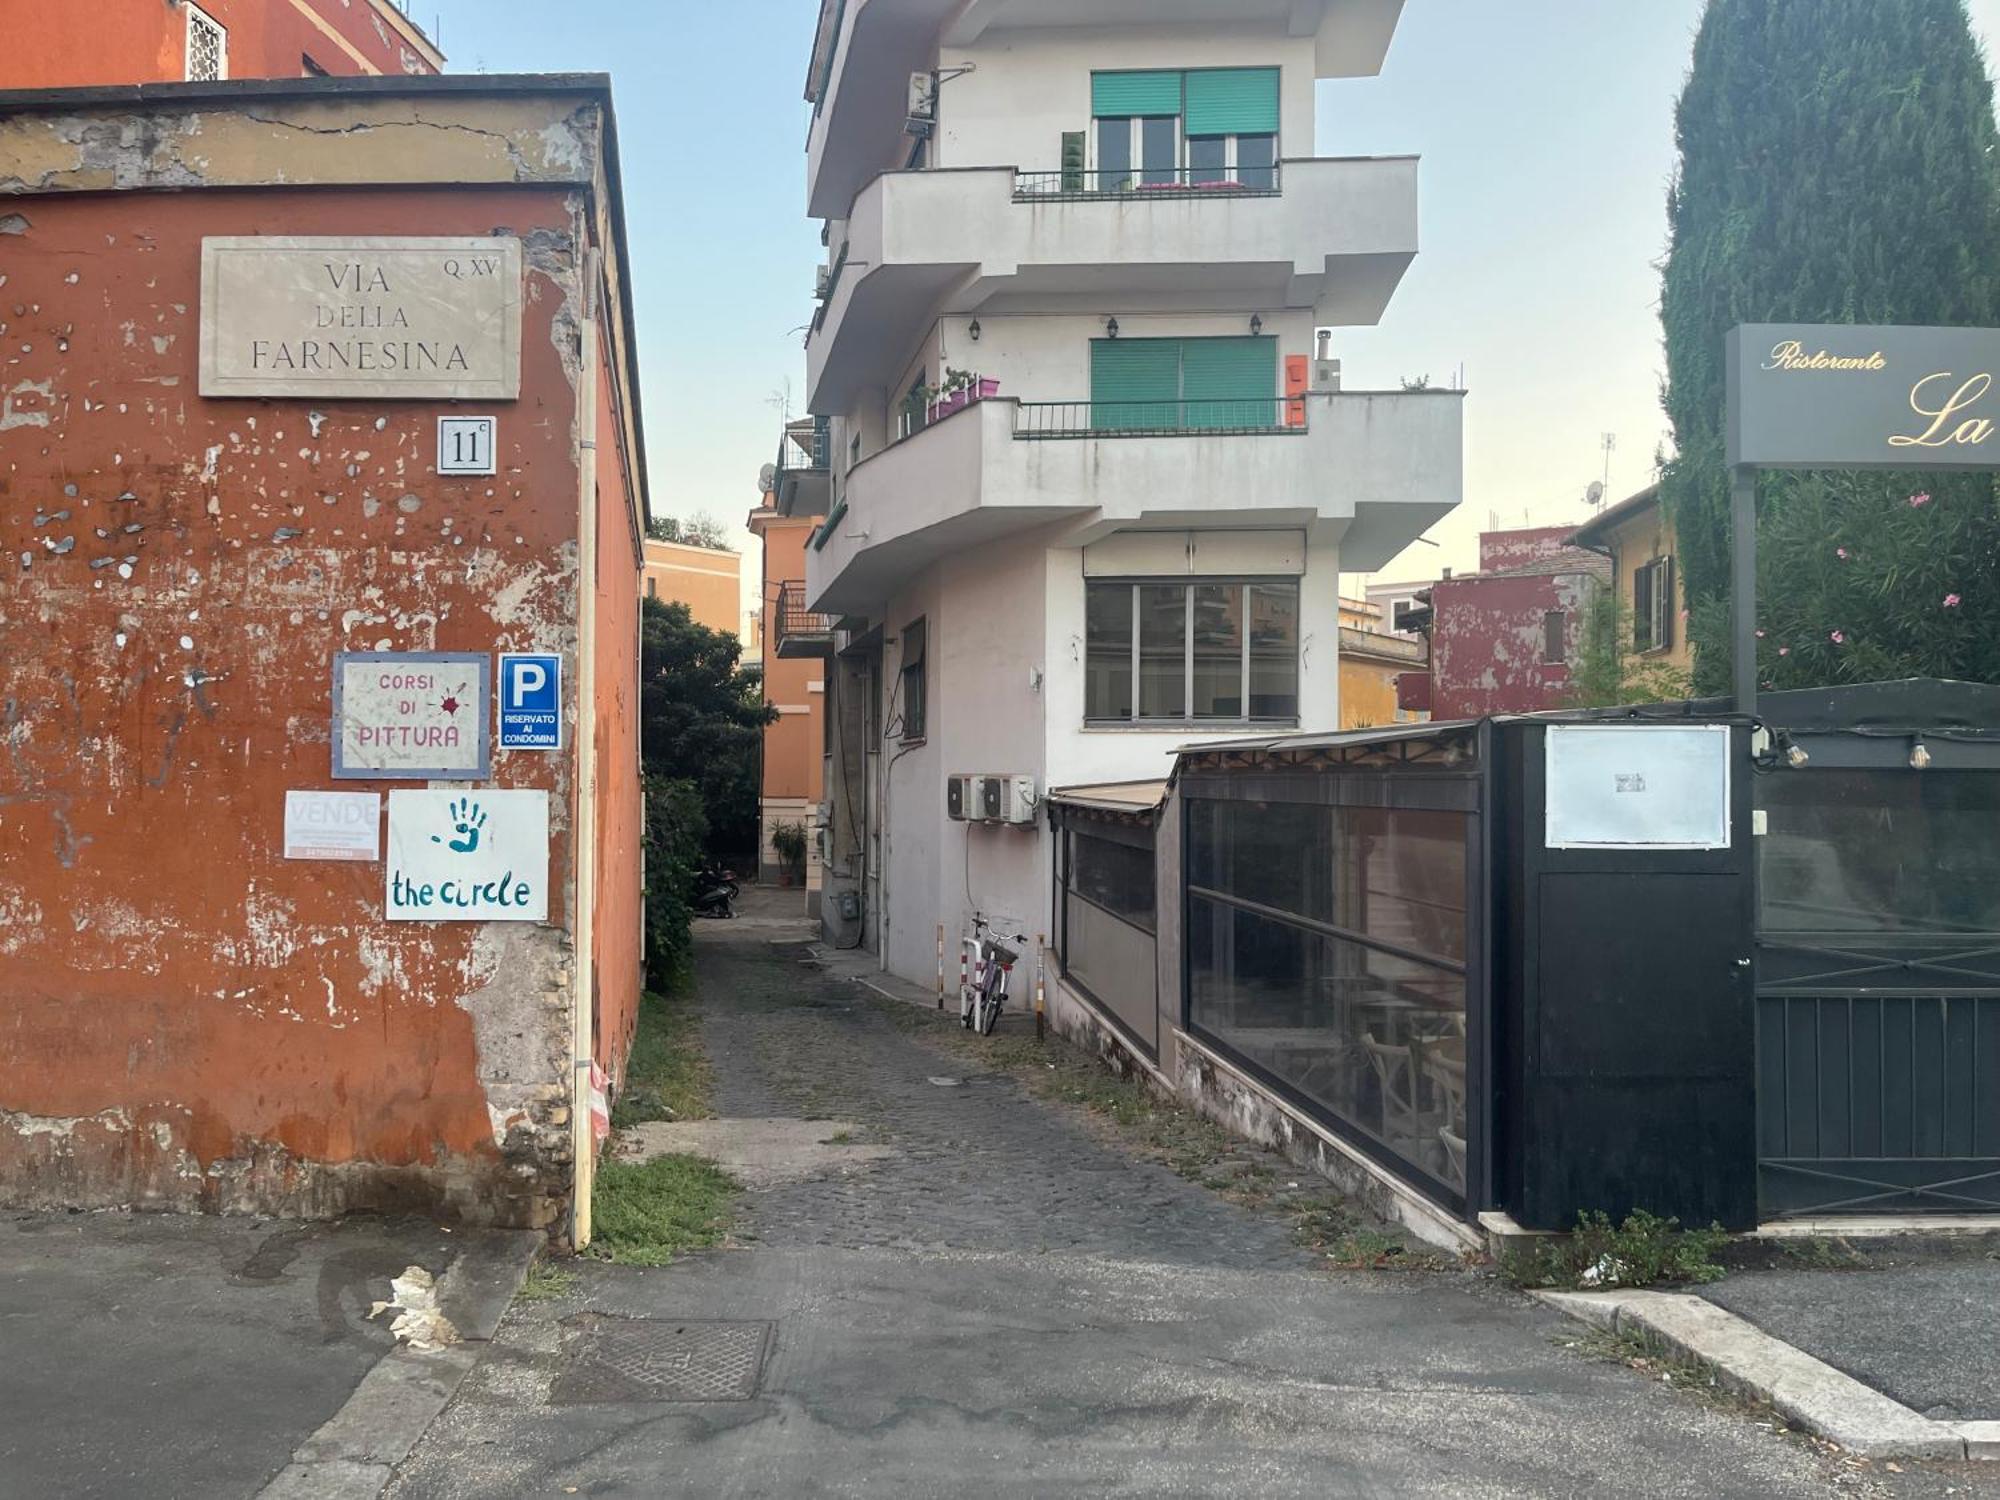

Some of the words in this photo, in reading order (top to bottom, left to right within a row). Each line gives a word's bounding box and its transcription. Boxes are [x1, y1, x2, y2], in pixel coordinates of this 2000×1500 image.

[471, 259, 498, 275] XV
[323, 264, 391, 292] VIA
[315, 306, 409, 328] DELLA
[252, 341, 470, 370] FARNESINA
[1760, 340, 1887, 371] Ristorante
[1887, 372, 1995, 446] La
[379, 674, 434, 690] CORSI
[513, 663, 546, 707] P
[400, 701, 416, 715] DI
[504, 714, 556, 724] RISERVATO
[523, 724, 533, 733] AI
[359, 726, 459, 747] PITTURA
[504, 734, 556, 744] CONDOMINI
[391, 870, 433, 907] the
[439, 870, 531, 907] circle
